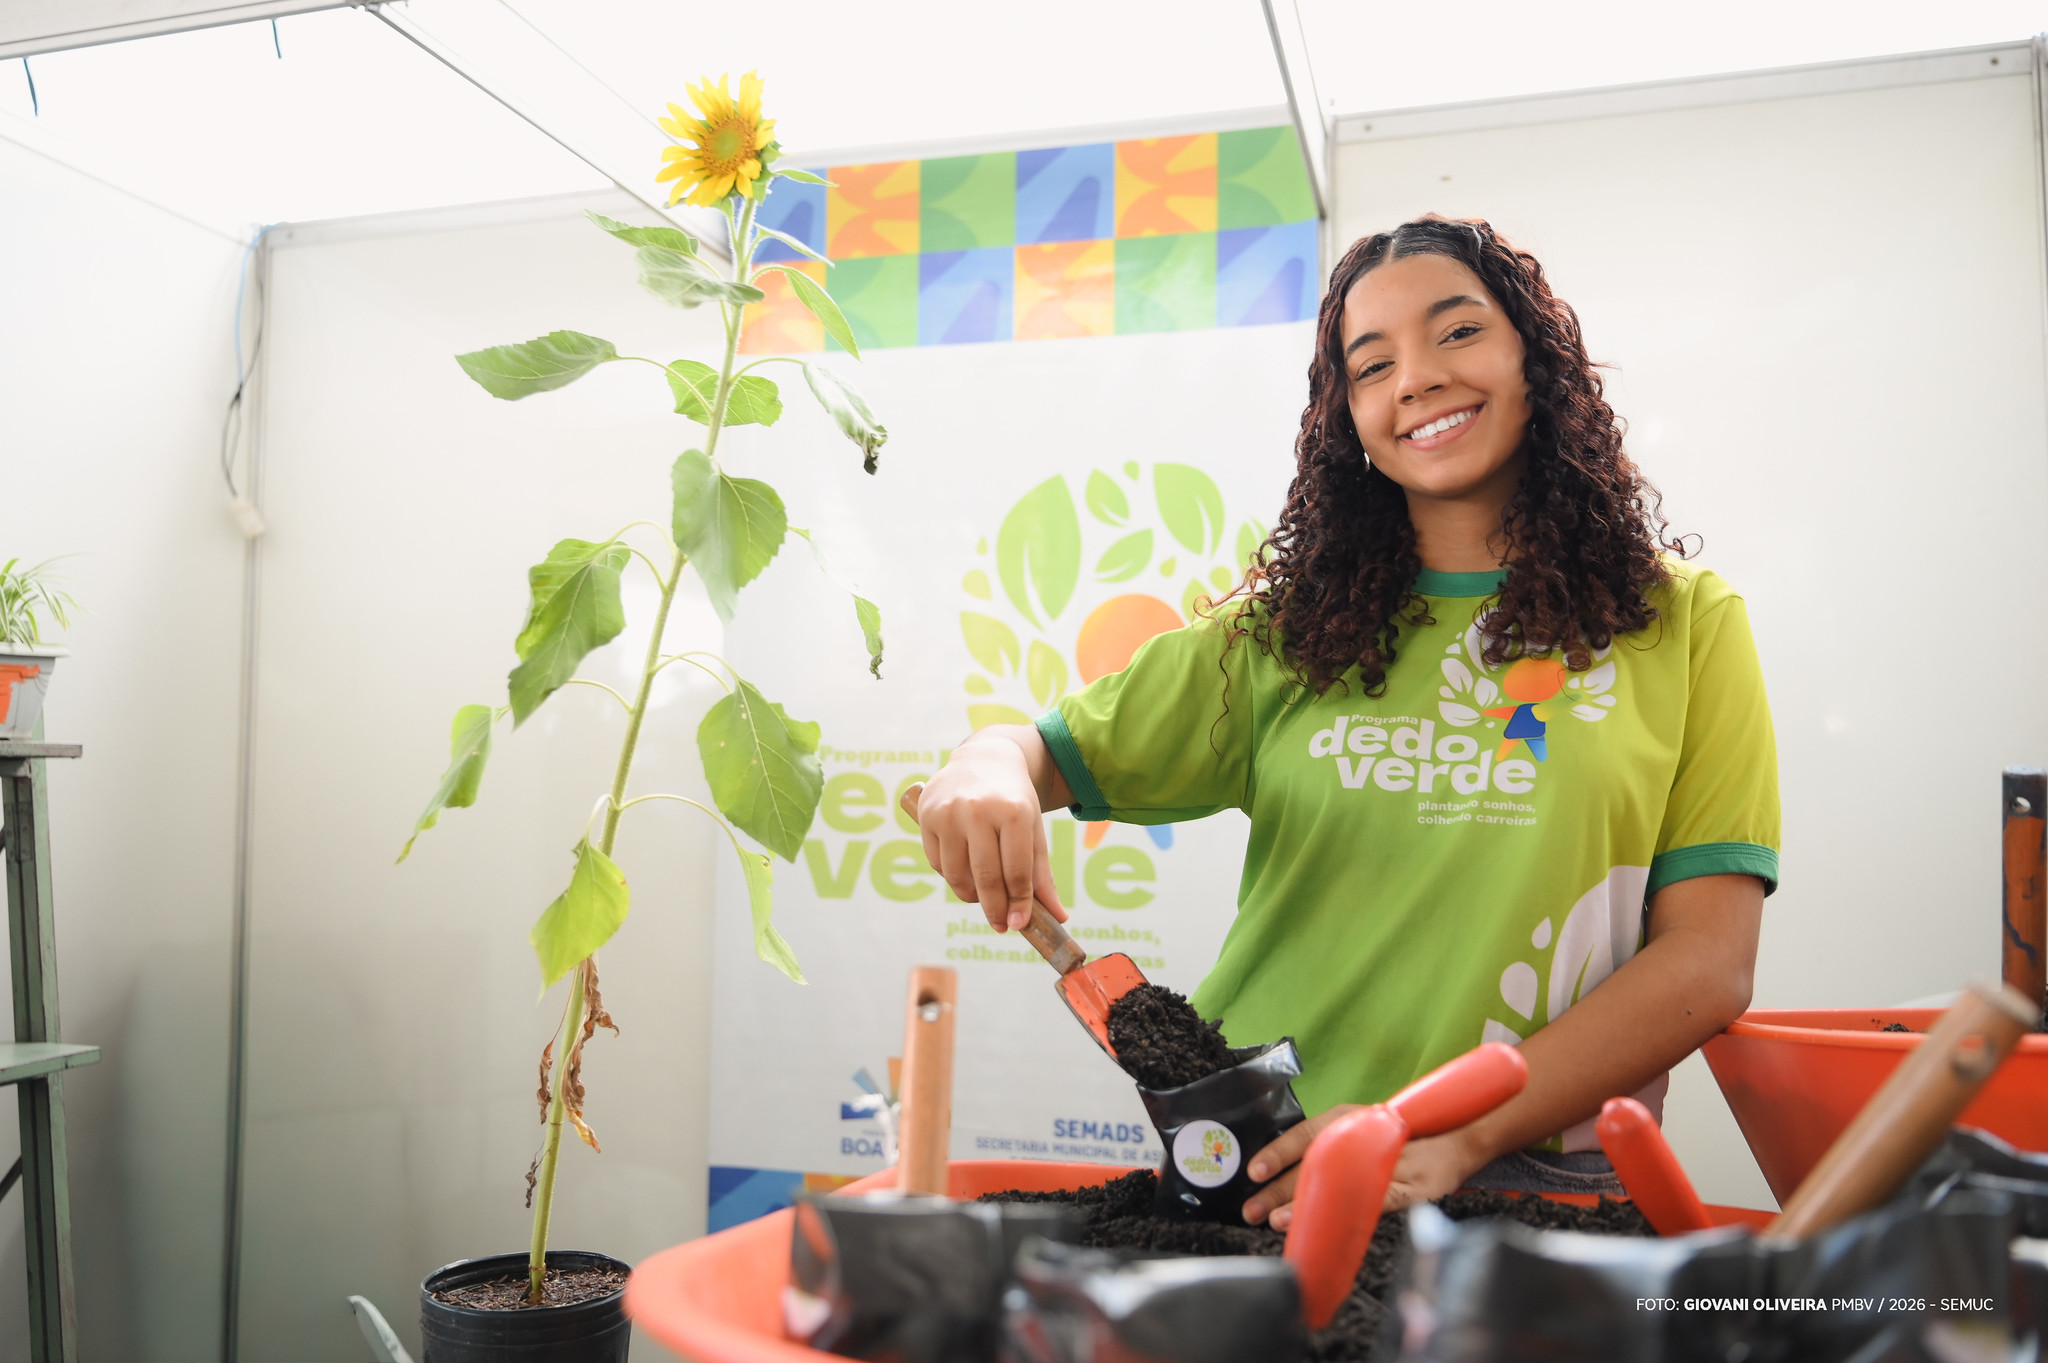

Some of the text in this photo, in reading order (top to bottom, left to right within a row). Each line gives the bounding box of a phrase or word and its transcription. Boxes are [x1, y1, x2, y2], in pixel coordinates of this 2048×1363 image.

[1351, 714, 1418, 726] Programa
[1308, 715, 1479, 763] dedo
[820, 745, 935, 768] Programa
[1335, 749, 1537, 795] verde
[1483, 800, 1536, 813] sonhos,
[1476, 814, 1537, 826] carreiras
[803, 818, 1157, 911] vee
[1070, 923, 1161, 946] sonhos,
[1053, 1117, 1145, 1144] SEMADS
[841, 1137, 884, 1157] BOA
